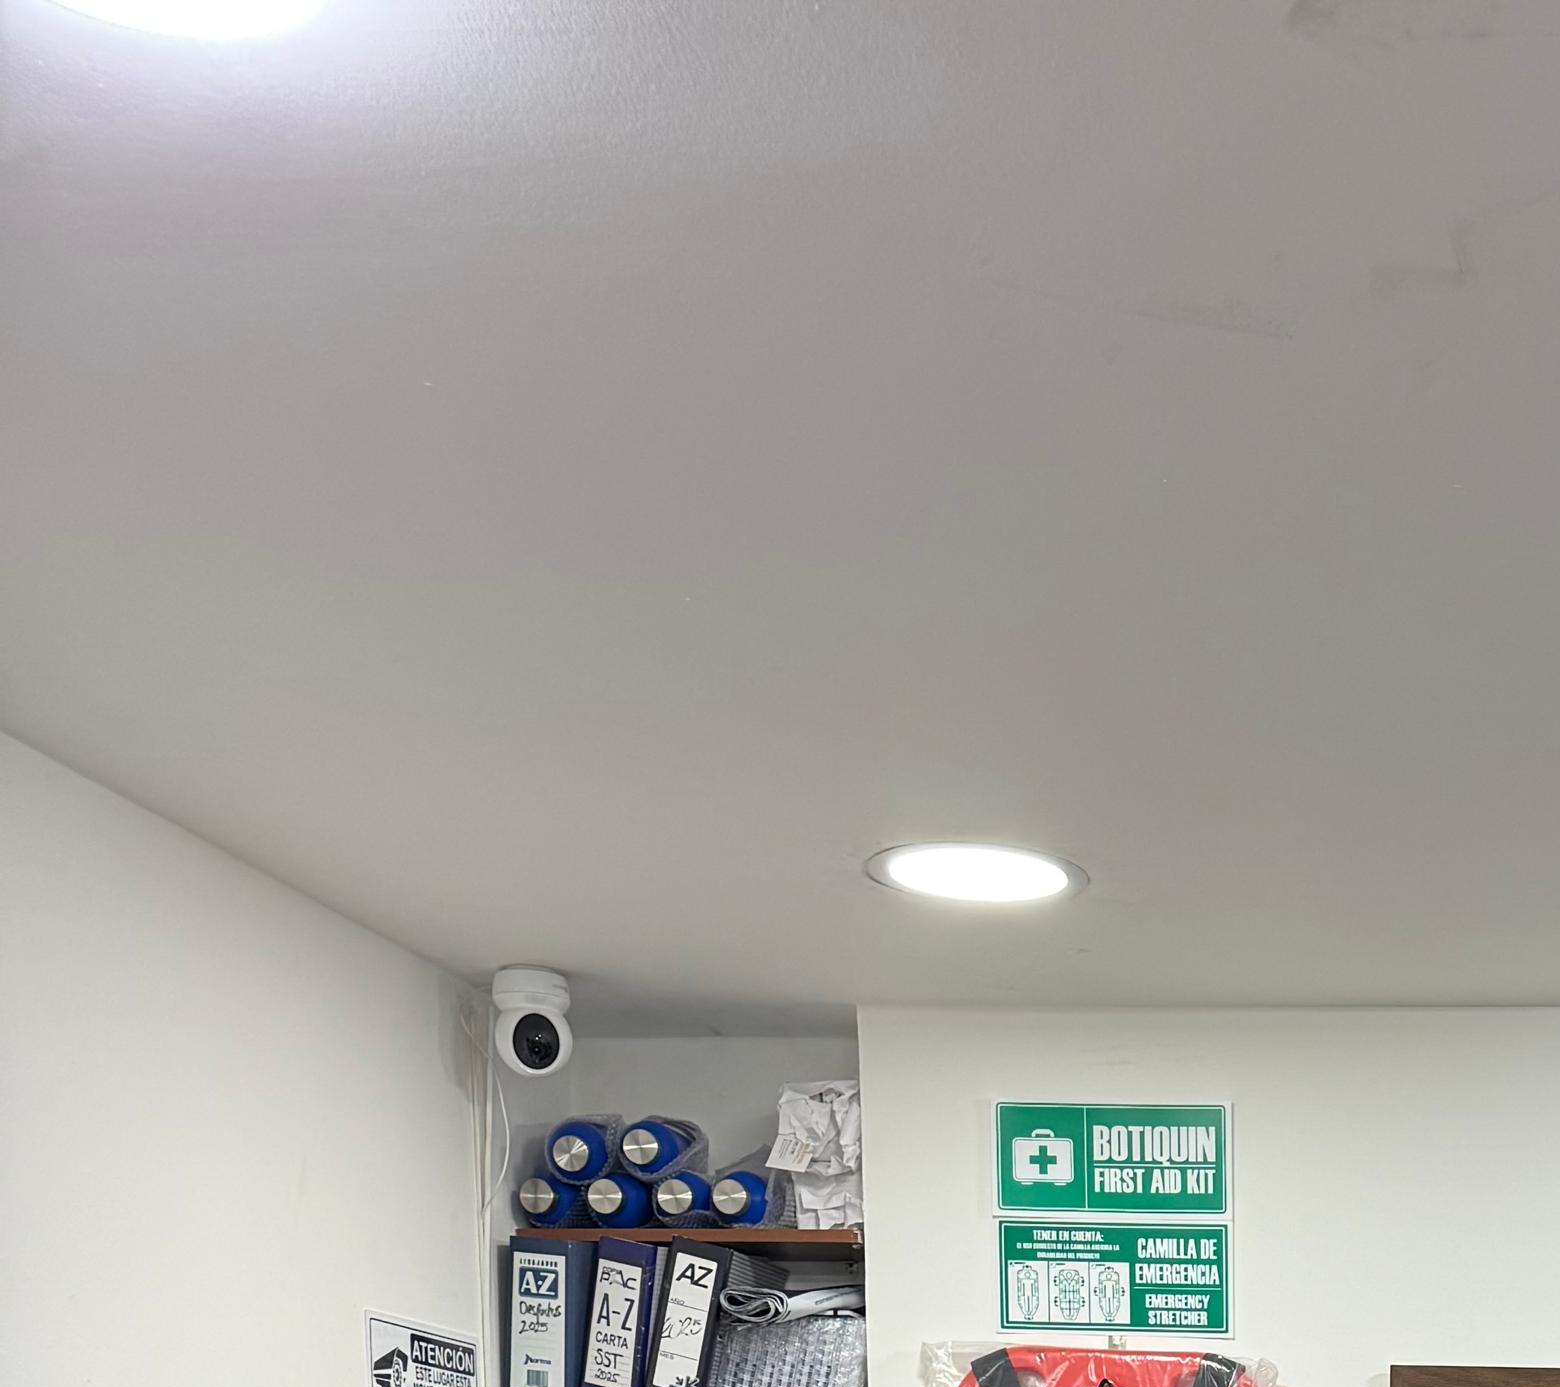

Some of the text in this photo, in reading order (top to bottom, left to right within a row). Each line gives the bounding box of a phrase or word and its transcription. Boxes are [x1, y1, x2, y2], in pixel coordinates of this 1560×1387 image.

[1092, 1125, 1216, 1165] BOTIQUIN
[1094, 1168, 1216, 1194] FIRST AID KIT
[1137, 1237, 1217, 1260] CAMILLA DE
[676, 1263, 714, 1289] AZ
[1135, 1263, 1220, 1286] EMERGENCIA
[596, 1292, 635, 1332] A-Z
[1145, 1293, 1210, 1310] EMERGENCY
[1148, 1310, 1208, 1326] STRETCHER
[595, 1331, 629, 1350] CARTA
[412, 1339, 475, 1374] ATENCIÓN
[415, 1366, 432, 1382] ESTE
[433, 1370, 455, 1387] LUGAR
